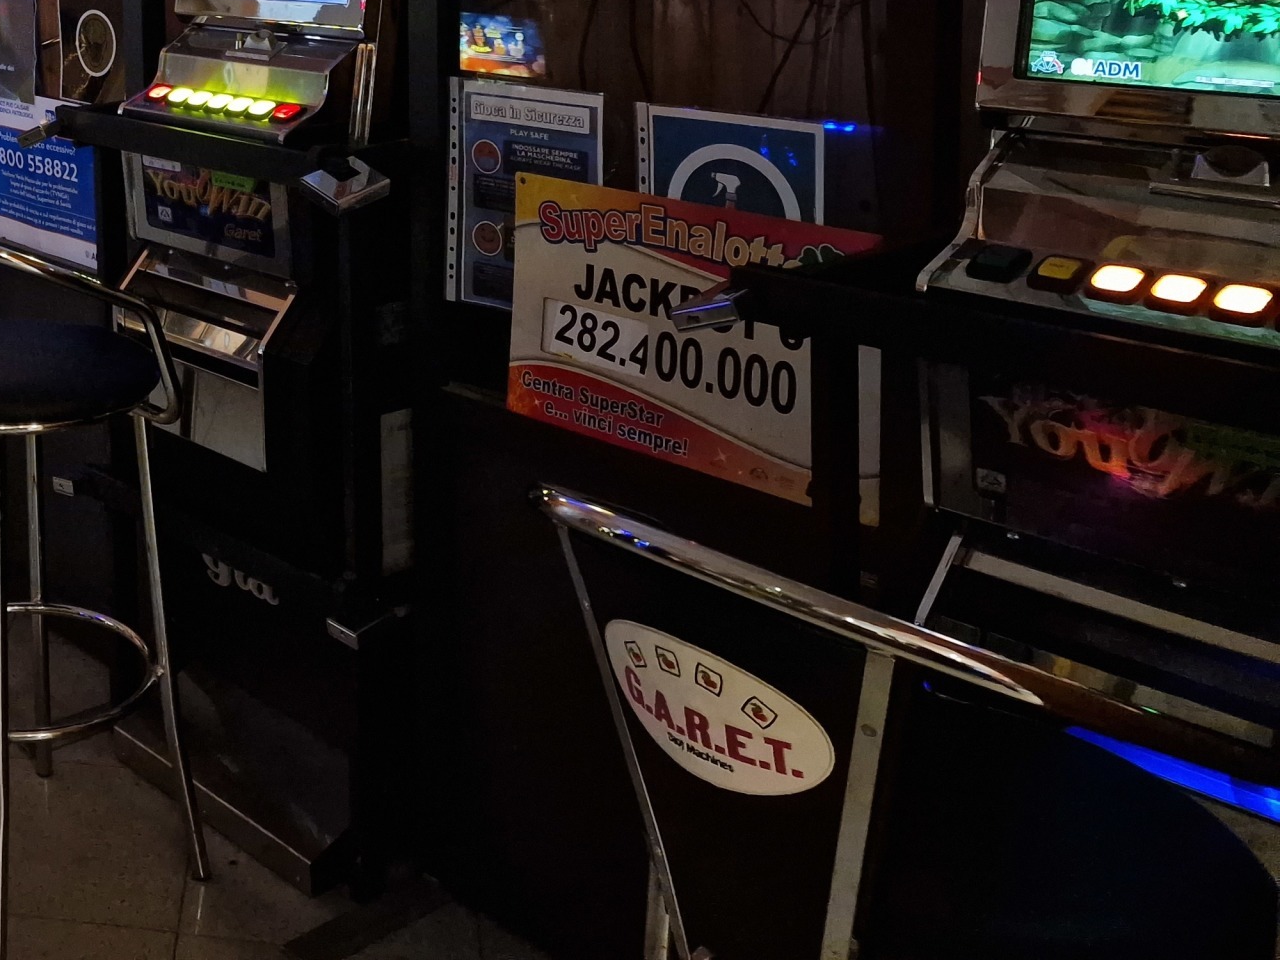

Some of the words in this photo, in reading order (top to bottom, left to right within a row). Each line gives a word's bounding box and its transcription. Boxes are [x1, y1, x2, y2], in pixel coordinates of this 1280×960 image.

[1094, 60, 1140, 78] ADM
[473, 100, 506, 117] Gioca
[509, 104, 521, 118] in
[524, 106, 584, 128] Sicurezza
[509, 128, 528, 136] PLAY
[530, 130, 549, 140] SAFE
[27, 155, 78, 183] 558822
[223, 223, 264, 242] Garet
[538, 200, 806, 268] SuperEnalott
[554, 304, 797, 415] 282.400.000
[522, 371, 573, 401] Centra
[578, 387, 664, 428] SuperStar
[544, 401, 568, 419] e...
[573, 408, 613, 434] vinci
[617, 422, 688, 458] sempre!
[624, 665, 805, 779] G.A.R.E.T.
[686, 743, 734, 773] Machines
